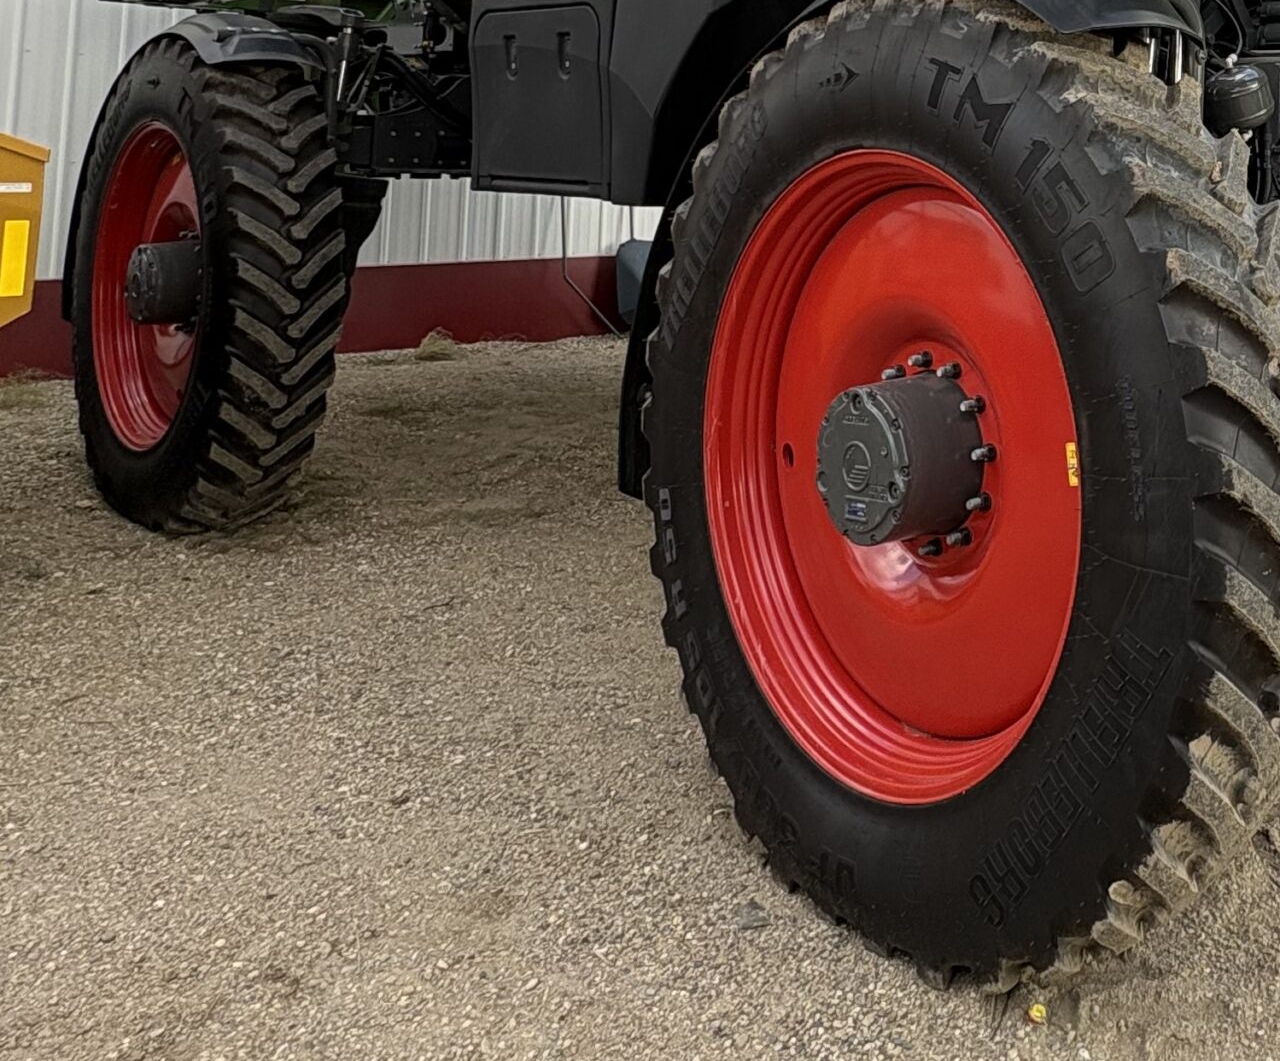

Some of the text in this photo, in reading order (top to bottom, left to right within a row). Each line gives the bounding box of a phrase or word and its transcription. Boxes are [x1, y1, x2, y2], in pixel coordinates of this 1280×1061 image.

[926, 56, 1117, 296] TM 150
[656, 484, 680, 567] 50
[968, 625, 1176, 931] TRELLEBORG
